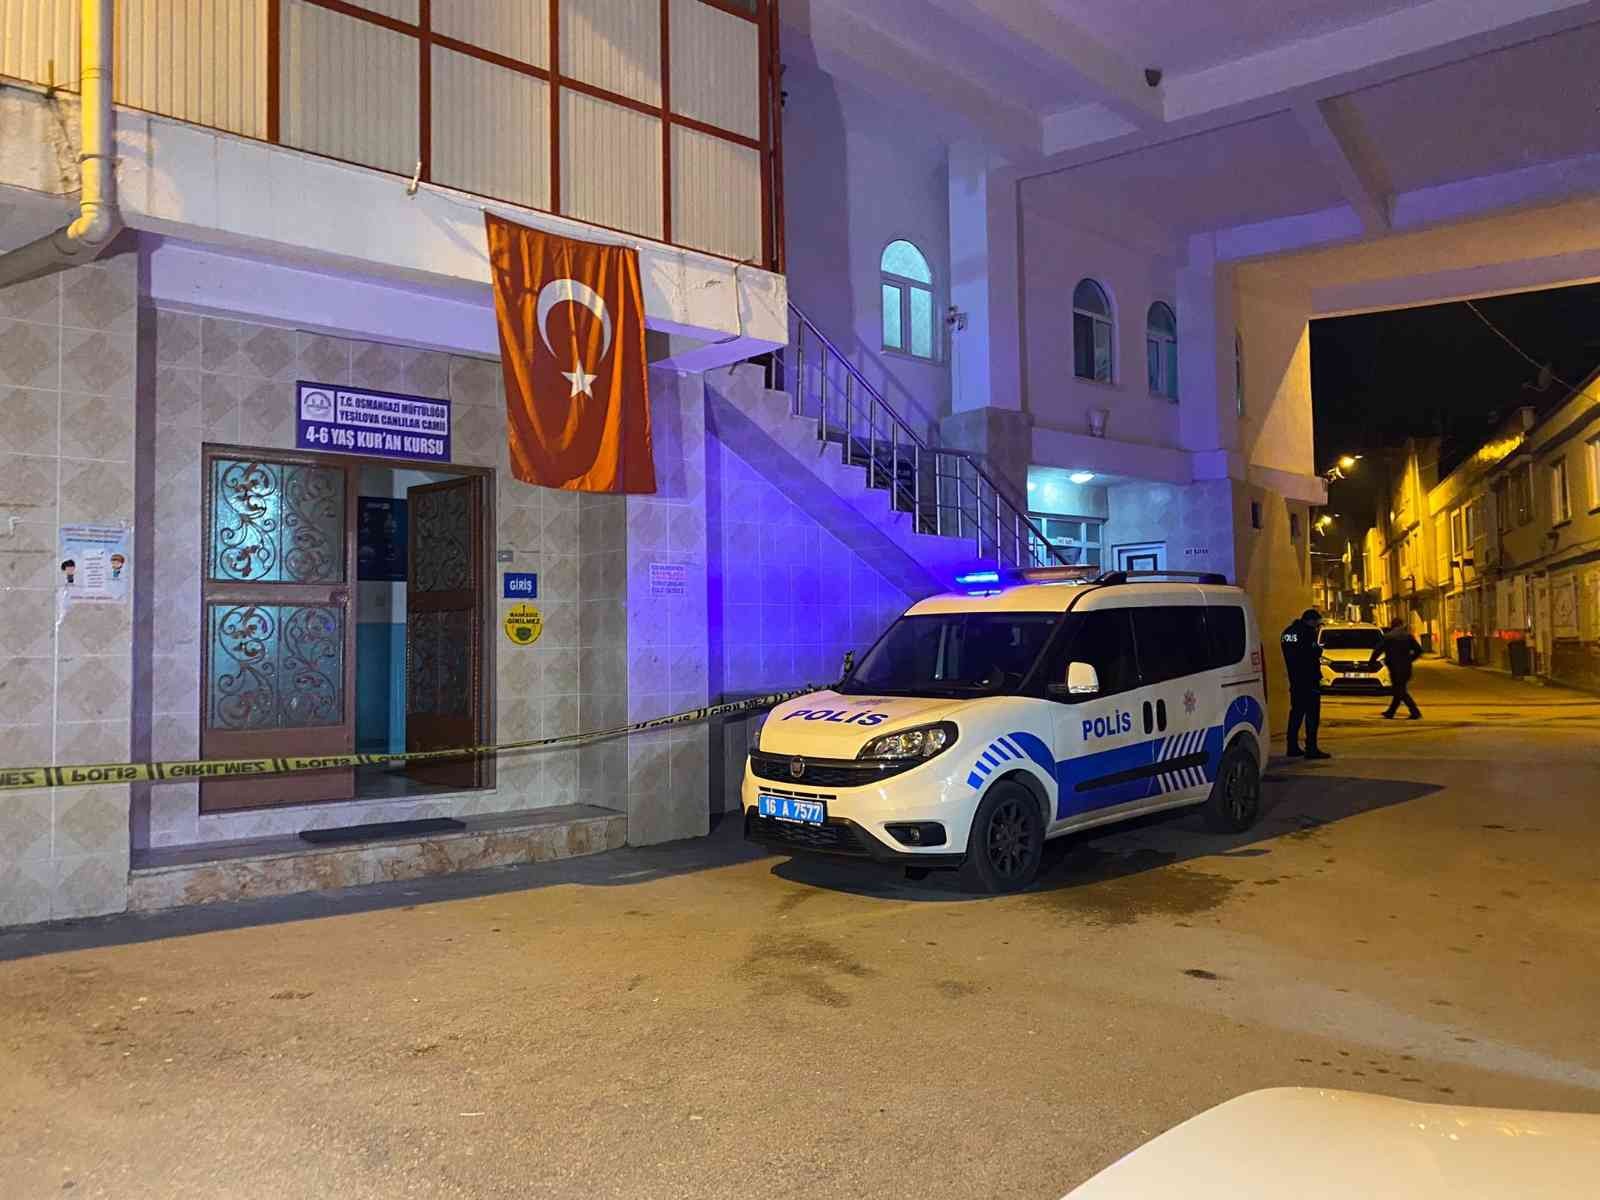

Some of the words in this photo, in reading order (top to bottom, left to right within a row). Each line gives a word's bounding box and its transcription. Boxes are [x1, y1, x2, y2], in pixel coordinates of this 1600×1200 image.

[340, 396, 353, 407] T.C.
[305, 426, 329, 444] 4-6
[331, 428, 355, 449] YAŞ
[357, 430, 401, 451] KUR'AN
[403, 435, 444, 455] KURSU
[509, 577, 533, 594] GİRİŞ
[781, 709, 889, 726] POLİS
[1081, 709, 1132, 741] POLİS
[766, 797, 777, 814] 16
[782, 801, 790, 817] A
[793, 801, 820, 820] 7577
